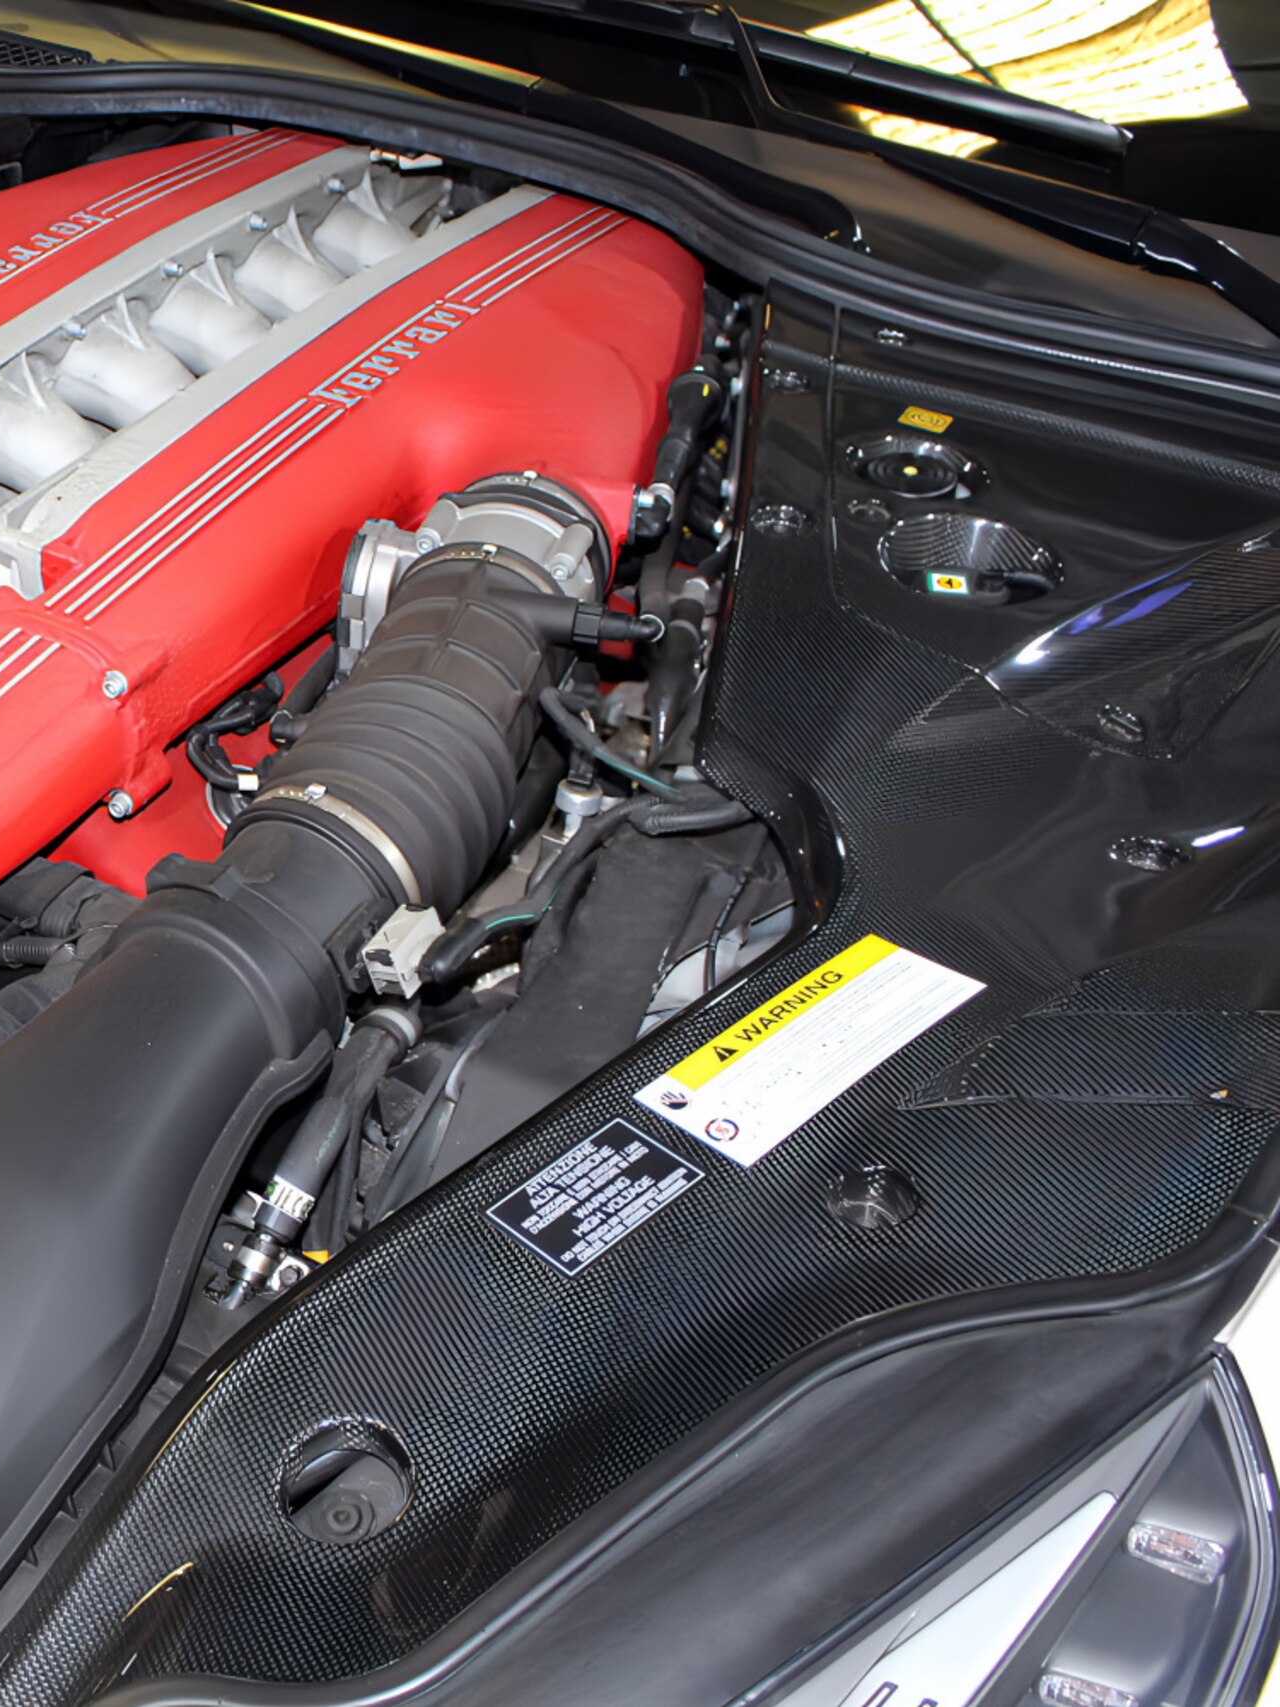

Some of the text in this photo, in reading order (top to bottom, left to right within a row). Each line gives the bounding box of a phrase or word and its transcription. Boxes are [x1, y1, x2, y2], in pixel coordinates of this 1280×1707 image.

[308, 299, 481, 408] Ferrari
[734, 970, 844, 1042] WARNING
[524, 1141, 598, 1197] ATTENZIONE
[529, 1145, 616, 1210] ALTA TENSIONE
[571, 1175, 631, 1219] WARNING
[571, 1174, 656, 1237] HIGH VOLTAGE
